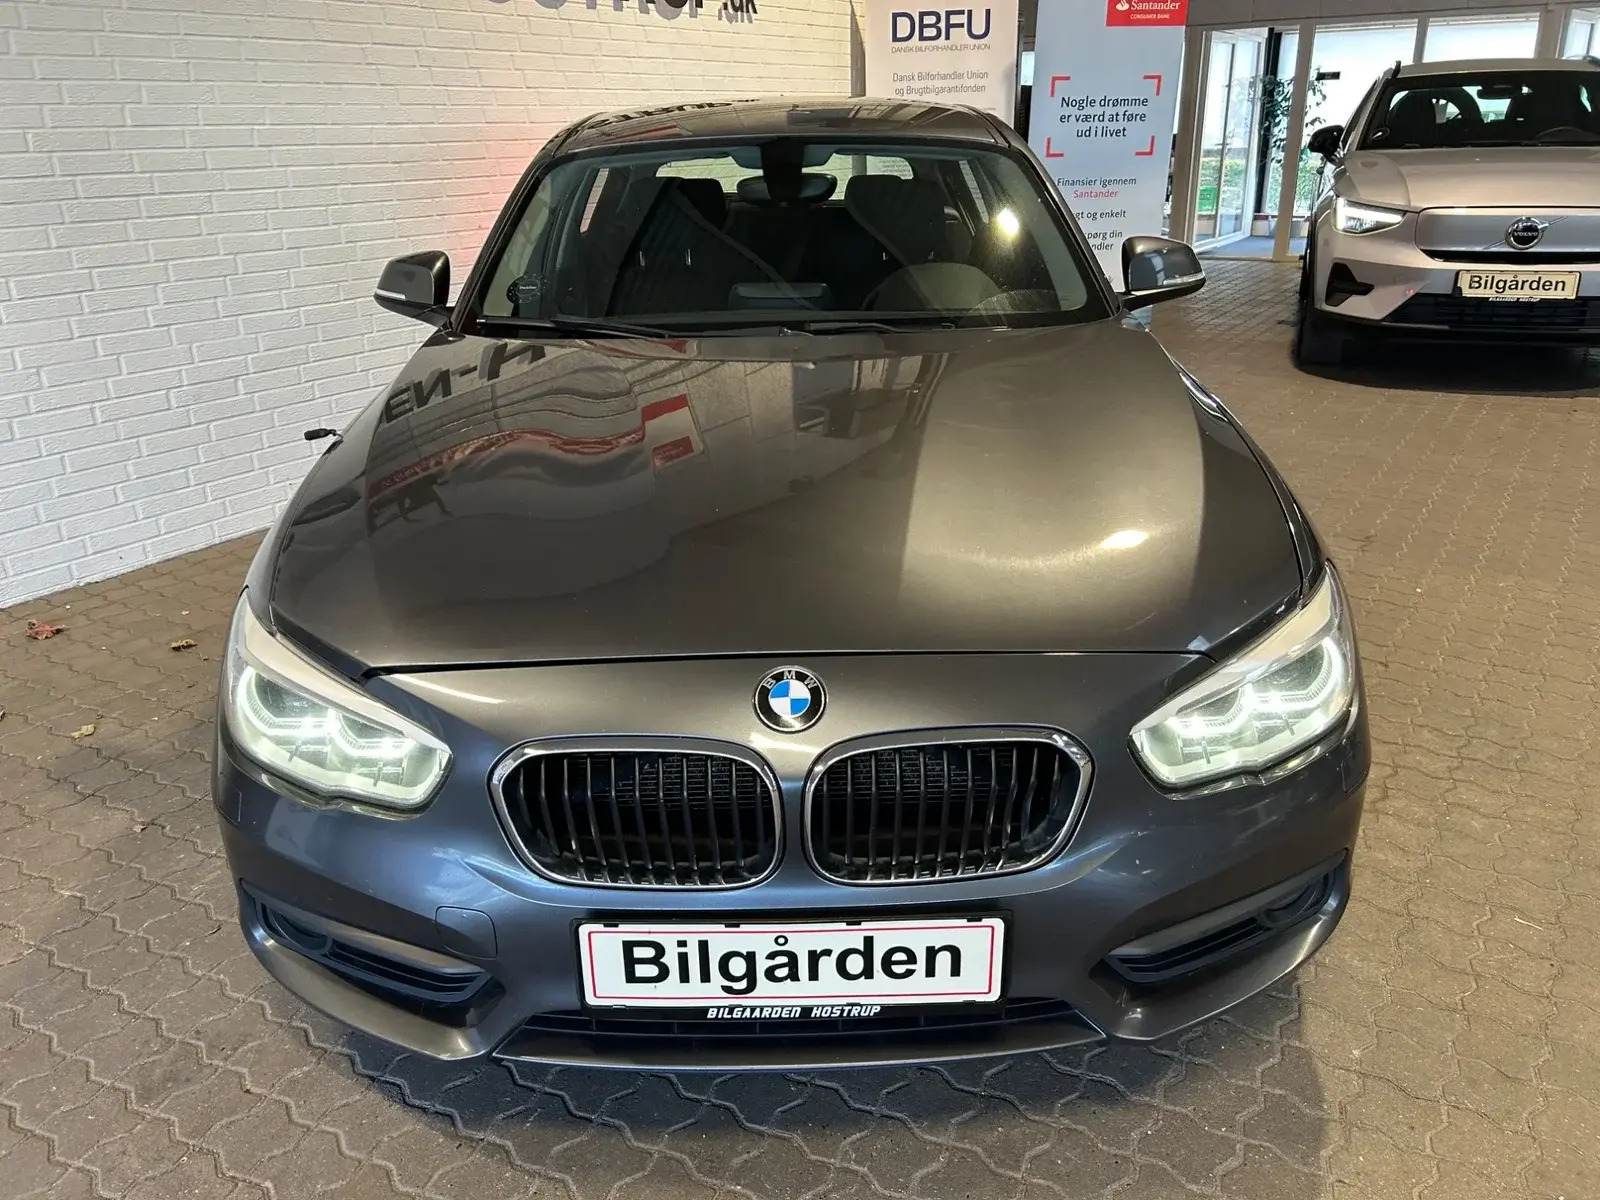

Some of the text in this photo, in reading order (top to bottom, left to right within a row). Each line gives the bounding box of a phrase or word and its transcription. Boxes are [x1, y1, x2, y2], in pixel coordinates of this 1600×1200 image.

[1131, 0, 1180, 10] Santander
[891, 8, 991, 42] DBFU
[915, 44, 968, 53] BILFORHANDLER
[969, 43, 991, 51] UNION
[892, 69, 989, 82] Dansk Bilforhandler Union
[895, 84, 986, 97] og Brugtbilgarantifonden
[1060, 95, 1149, 111] Nogle drømme
[1059, 110, 1147, 123] er værd at føre
[1076, 126, 1127, 138] ud i livet
[1057, 177, 1137, 188] Finansier igennem
[1073, 189, 1119, 199] Santander
[1086, 211, 1098, 221] og
[1099, 209, 1127, 218] enkelt
[1085, 230, 1123, 241] pørg din
[1468, 274, 1566, 294] Bilgården
[762, 669, 818, 690] BMW
[621, 934, 962, 996] Bilgården
[706, 1005, 881, 1019] BILGAARDEN HOSTRUP
